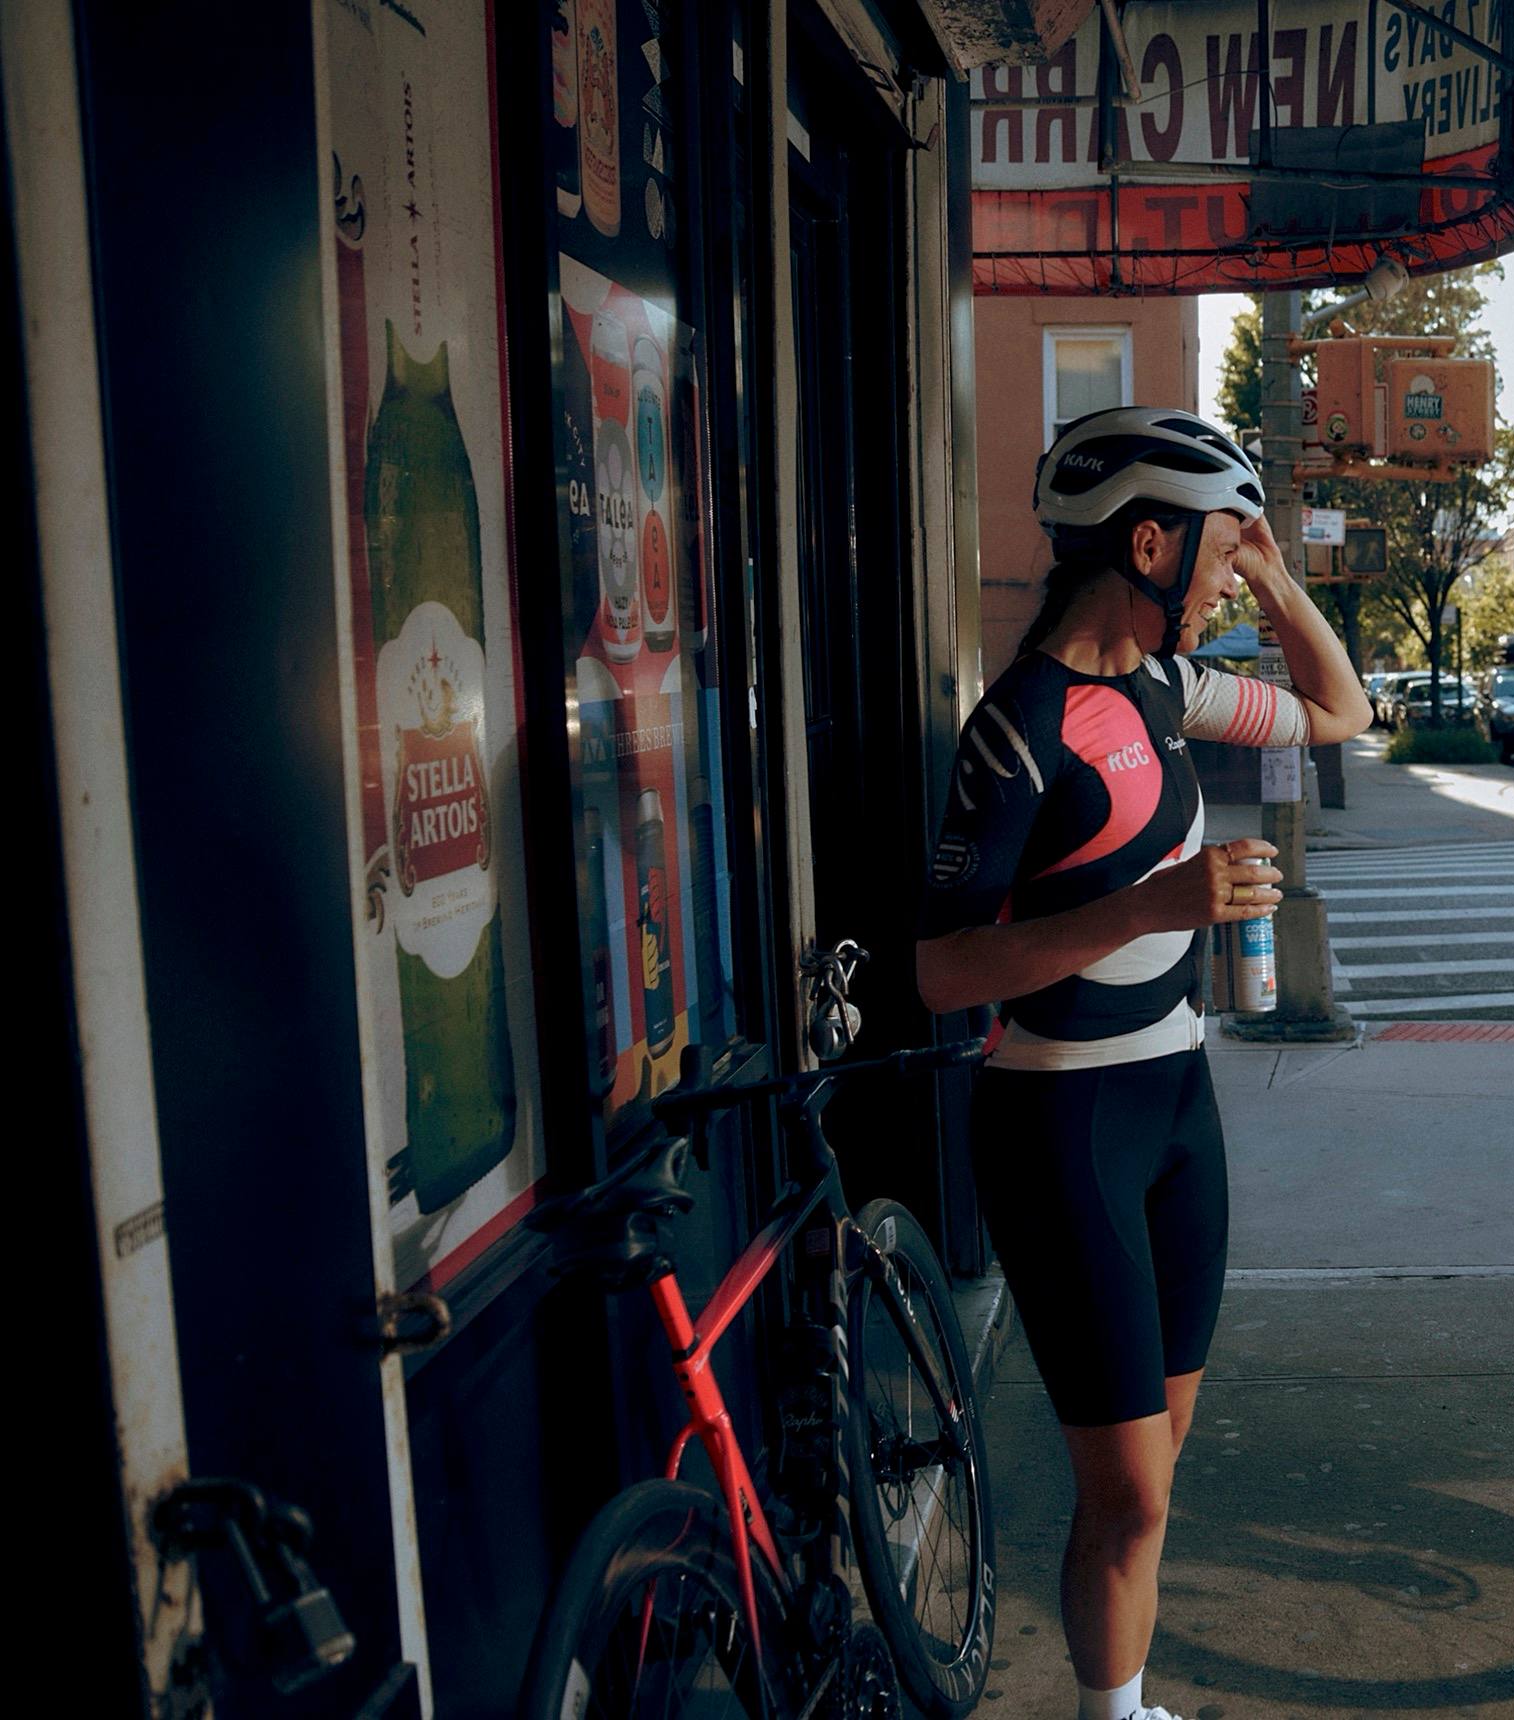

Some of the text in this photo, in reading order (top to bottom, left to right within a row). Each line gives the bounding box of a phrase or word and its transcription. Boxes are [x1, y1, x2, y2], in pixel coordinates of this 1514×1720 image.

[403, 80, 416, 189] ARTOIS
[1063, 453, 1105, 472] KASK
[654, 723, 684, 750] BREW
[1106, 741, 1150, 773] RCC
[407, 754, 475, 802] STELLA
[410, 797, 478, 849] ARTOIS
